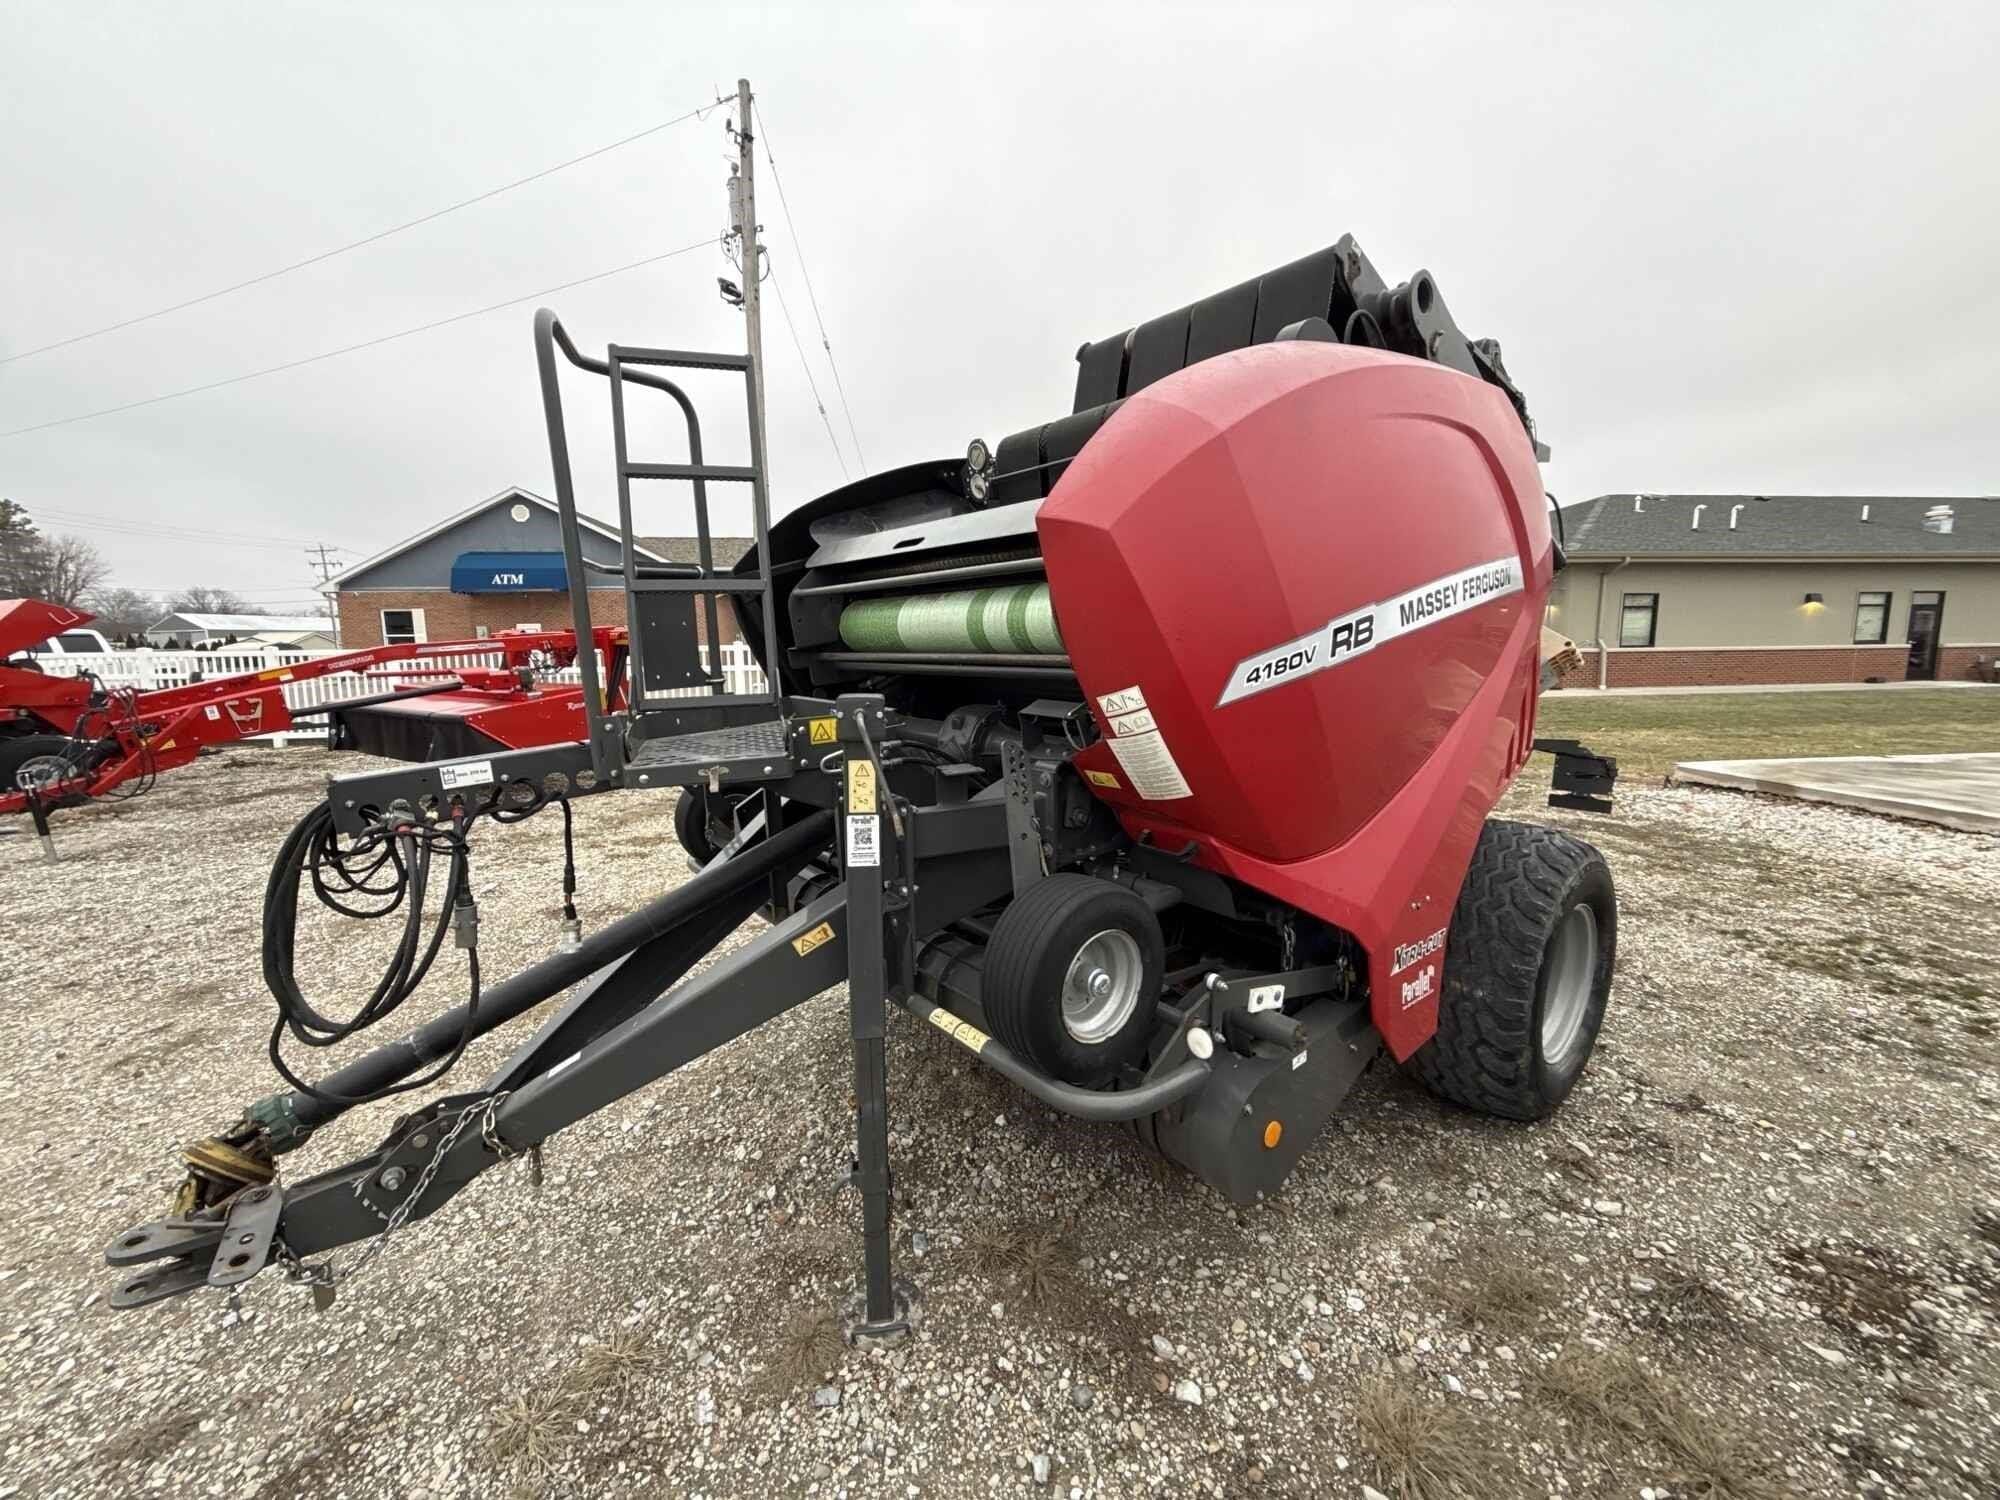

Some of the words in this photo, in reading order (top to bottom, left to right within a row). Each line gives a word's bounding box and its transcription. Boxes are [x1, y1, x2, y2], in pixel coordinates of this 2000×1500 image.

[491, 573, 524, 585] ATM
[1246, 645, 1317, 684] 4180V
[1330, 614, 1375, 658] RB
[1399, 582, 1458, 627] MASSEY
[1462, 567, 1511, 601] FERGUSON
